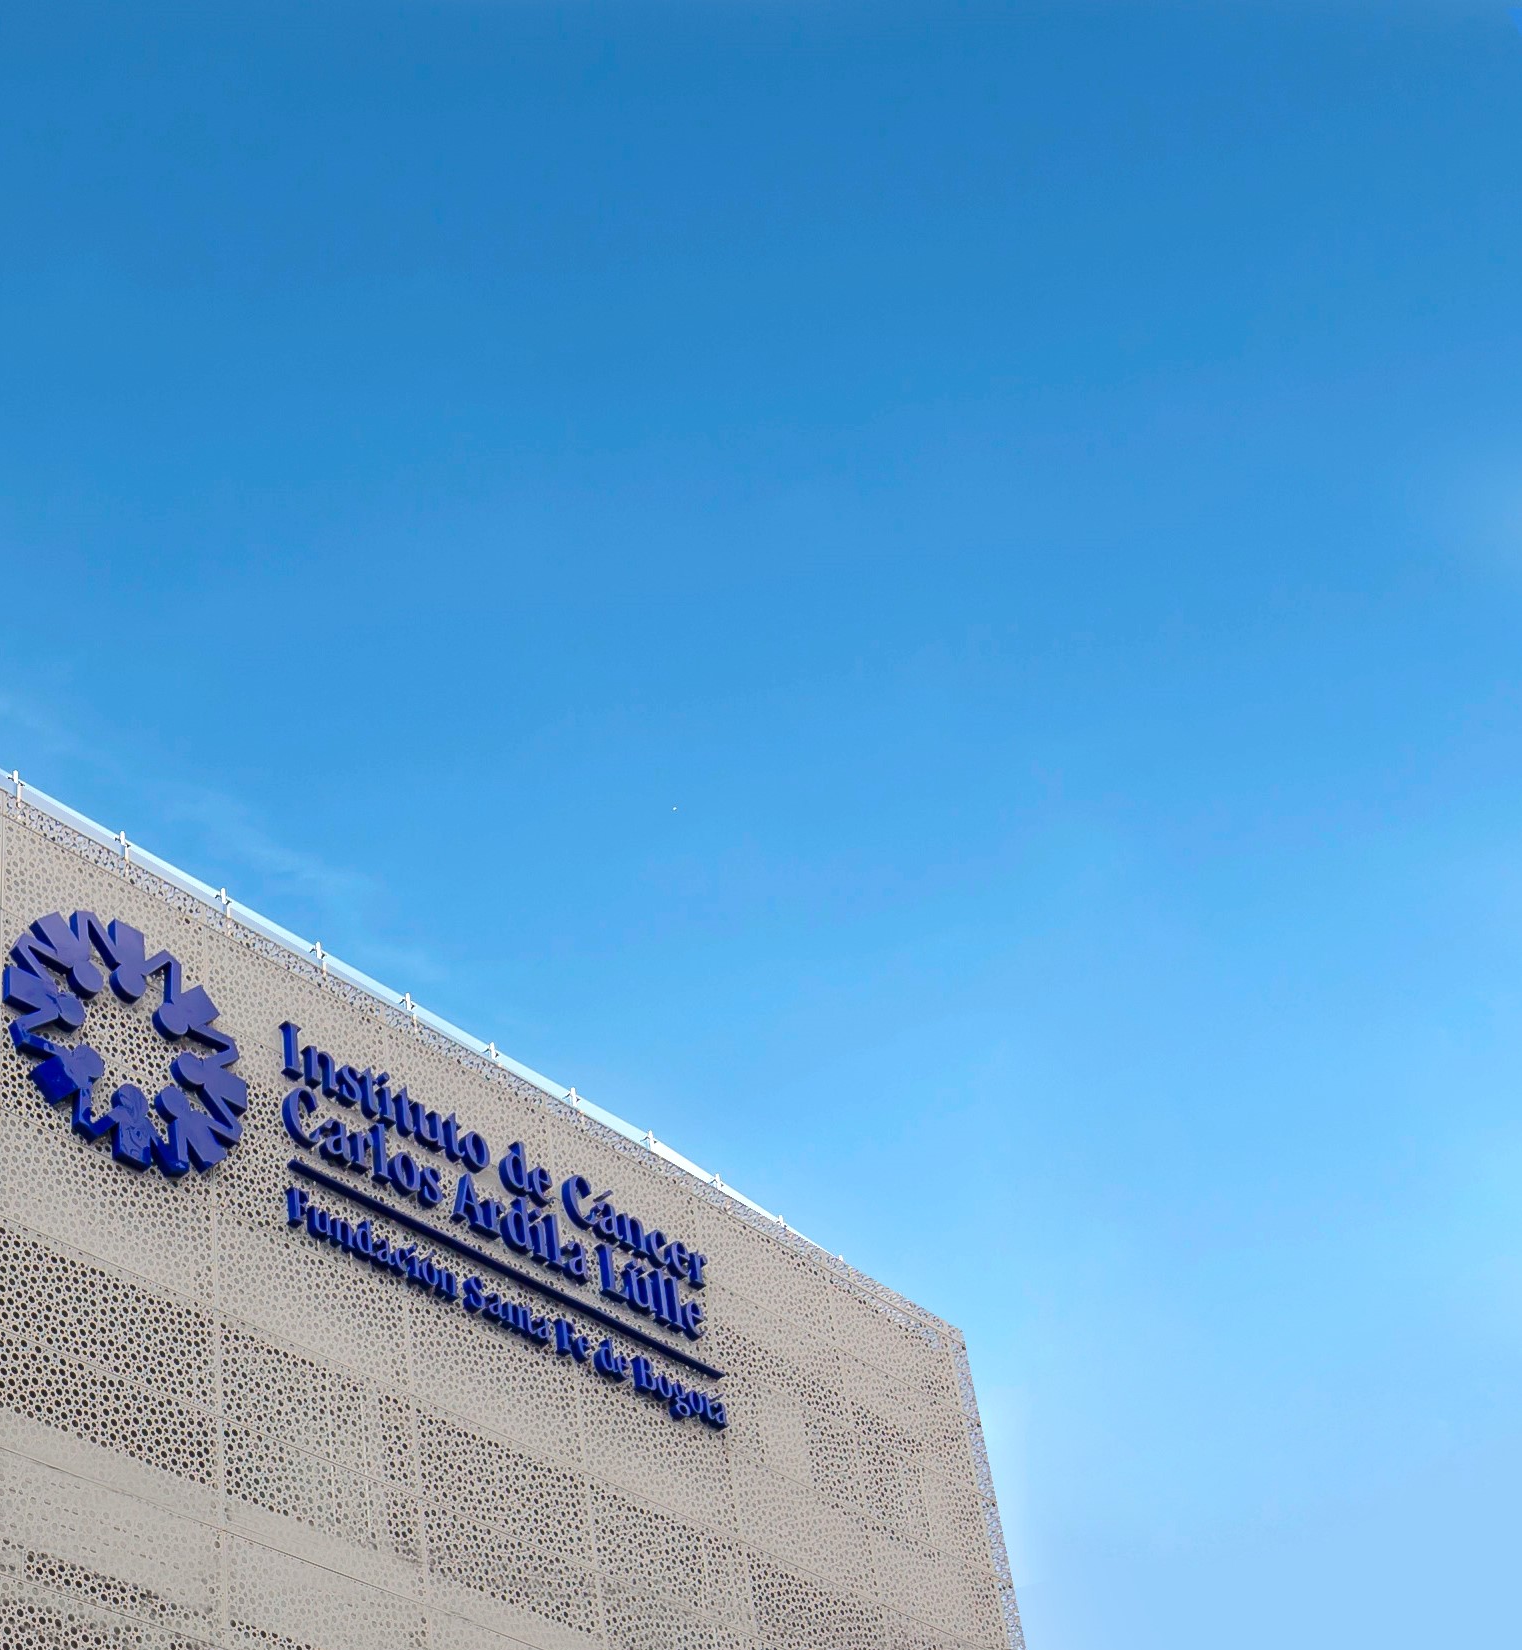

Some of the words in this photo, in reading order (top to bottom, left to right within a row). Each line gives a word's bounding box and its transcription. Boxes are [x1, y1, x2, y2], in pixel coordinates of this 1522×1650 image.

[278, 1020, 491, 1174] Instituto
[498, 1141, 554, 1208] de
[561, 1174, 708, 1290] Cáncer
[281, 1086, 444, 1209] Carlos
[449, 1172, 590, 1286] Ardila
[593, 1242, 707, 1342] Lülle
[284, 1186, 460, 1303] Fundación
[462, 1275, 552, 1348] Santa
[553, 1317, 592, 1364] Fe
[592, 1336, 630, 1384] de
[629, 1354, 729, 1432] Bogotá
